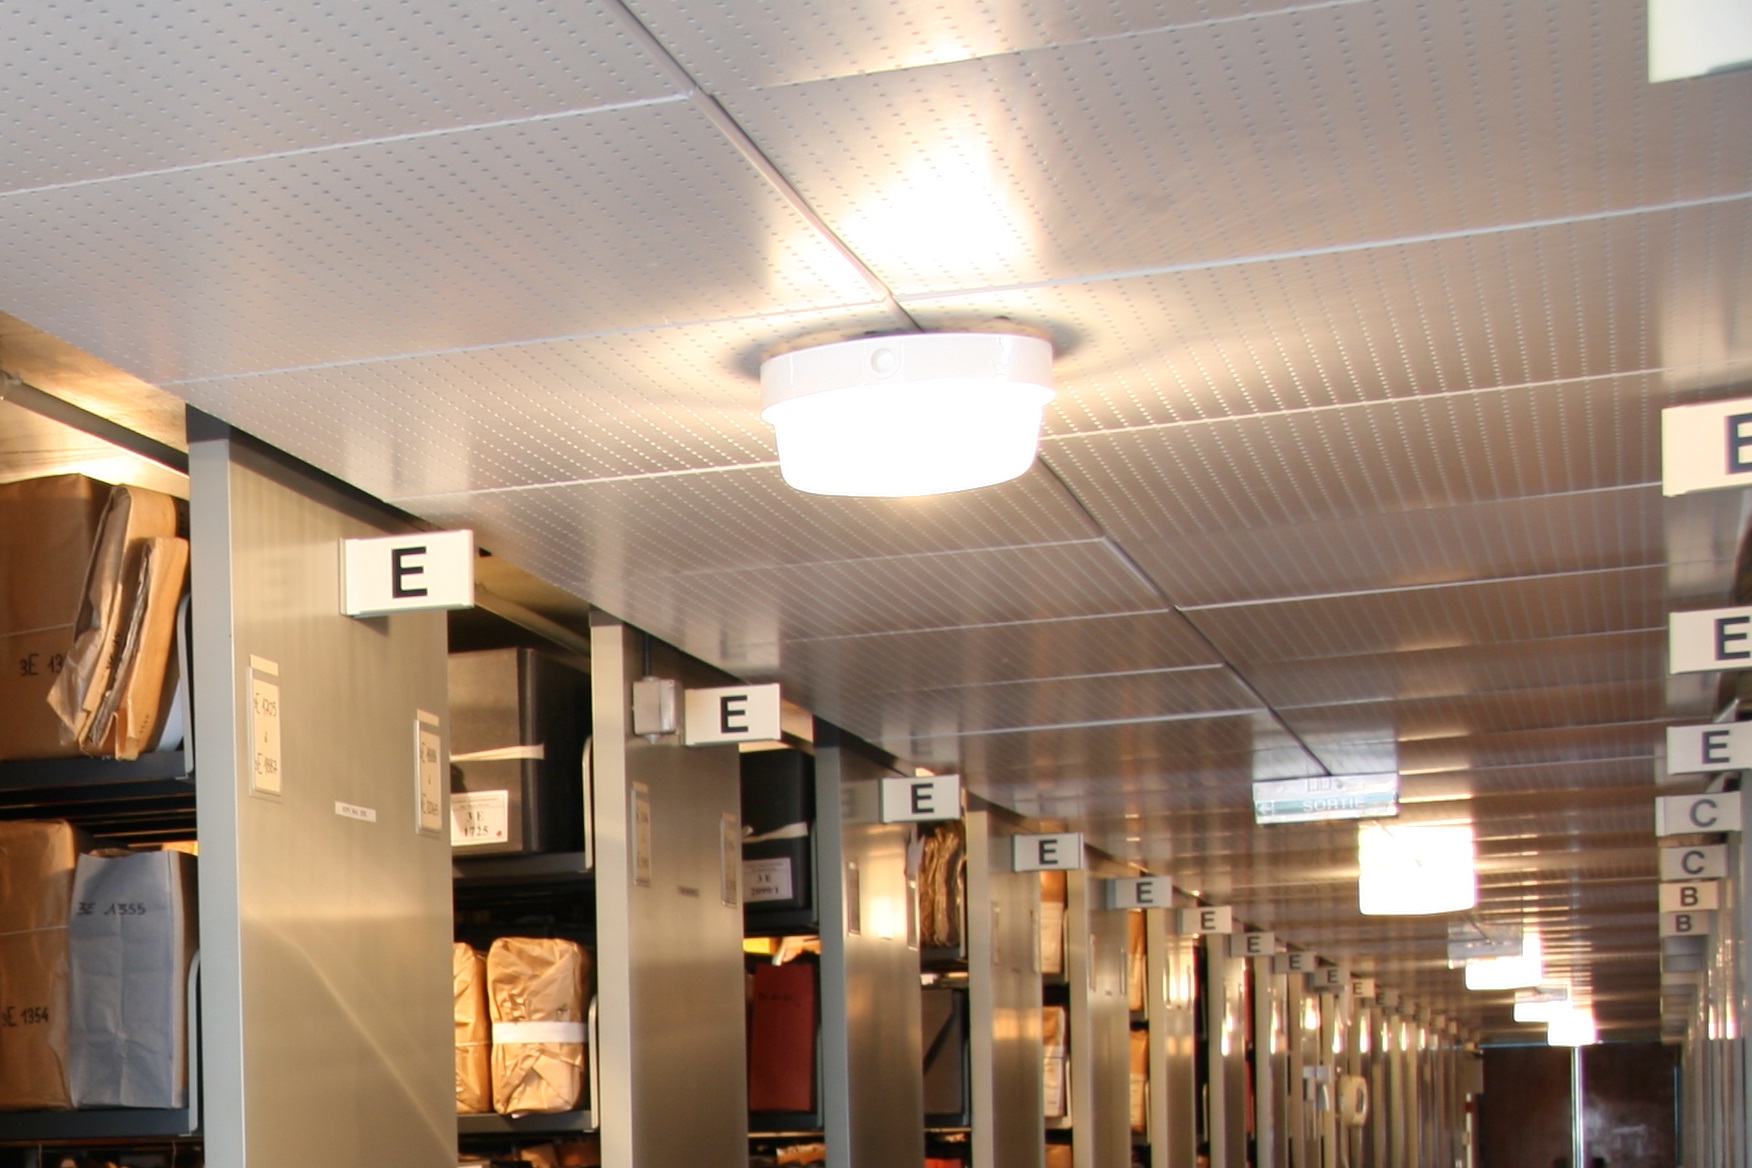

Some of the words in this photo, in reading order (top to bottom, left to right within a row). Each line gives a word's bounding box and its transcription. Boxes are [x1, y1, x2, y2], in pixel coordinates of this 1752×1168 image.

[392, 547, 428, 598] E
[1715, 616, 1751, 660] E
[720, 695, 748, 733] E
[1702, 730, 1730, 764] E
[911, 783, 934, 814] E
[1303, 796, 1366, 812] SORTIE
[1690, 799, 1717, 828] C
[1038, 839, 1058, 865] E
[1682, 850, 1705, 875] C
[1136, 882, 1153, 904] E
[1680, 886, 1699, 907] B
[1200, 911, 1215, 930] E
[1676, 914, 1692, 933] B
[1248, 936, 1260, 953] E
[1289, 955, 1301, 970] E
[1327, 969, 1338, 983] E
[1353, 982, 1362, 995] E
